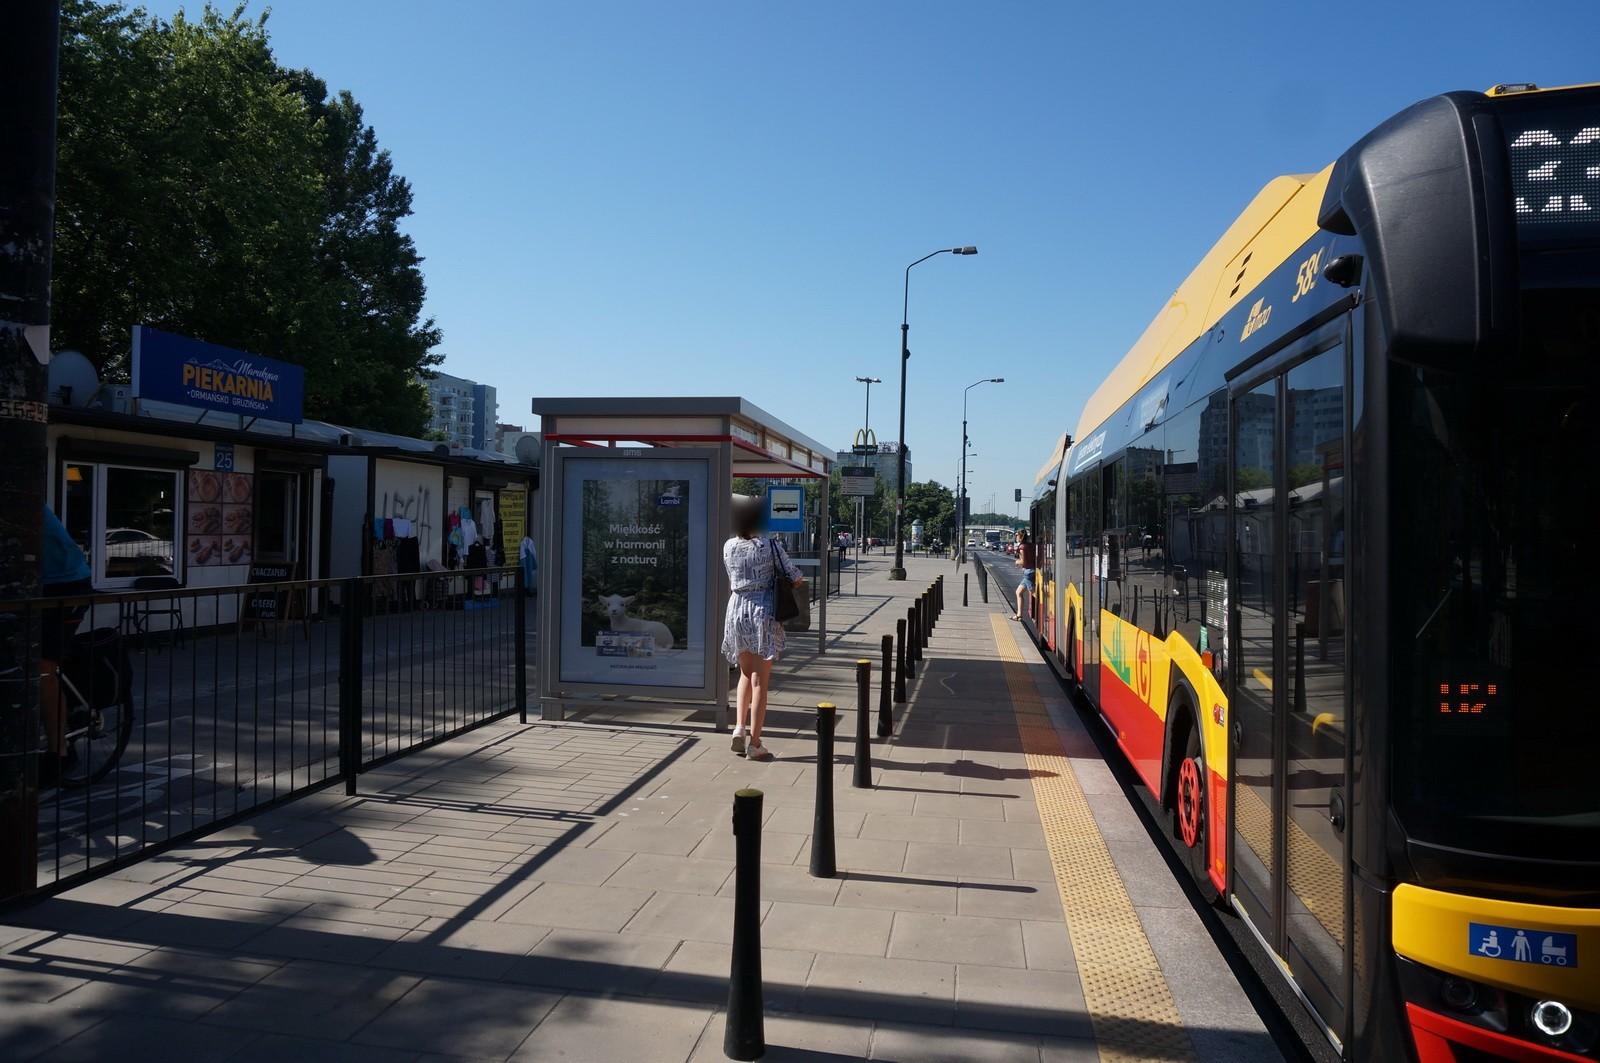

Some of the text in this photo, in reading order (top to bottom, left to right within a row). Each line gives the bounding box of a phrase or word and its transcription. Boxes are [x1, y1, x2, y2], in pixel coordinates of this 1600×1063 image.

[183, 363, 274, 401] PIEKARNIA
[216, 452, 232, 469] 25
[660, 497, 680, 505] Lambi
[609, 523, 662, 537] Miękkość
[604, 540, 666, 549] w harmonii
[611, 556, 658, 567] z naturą
